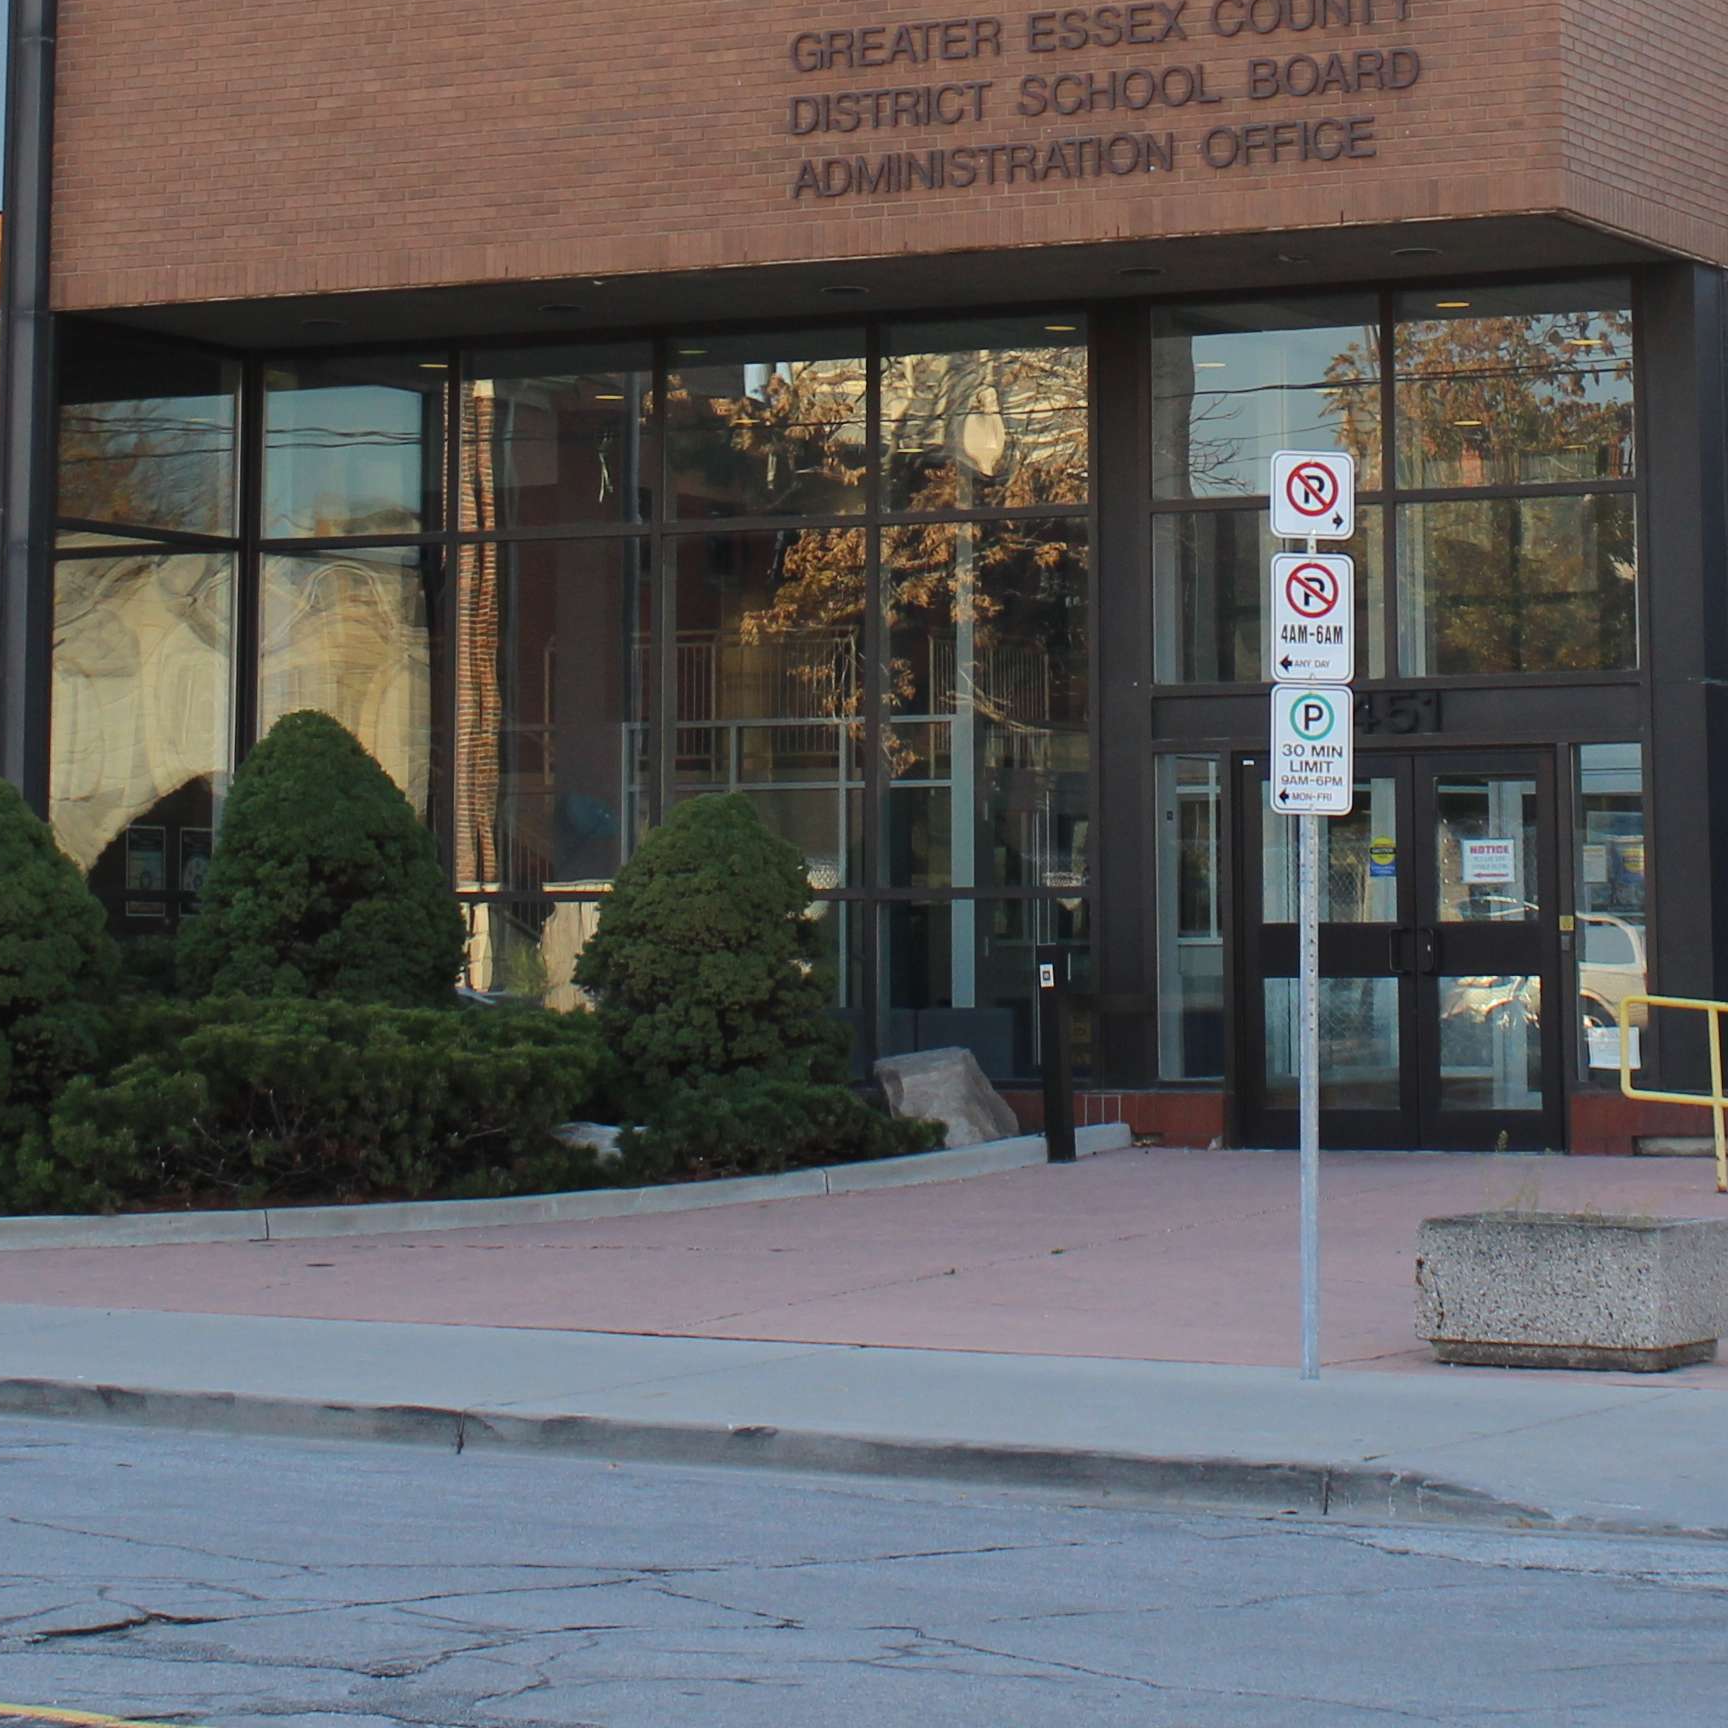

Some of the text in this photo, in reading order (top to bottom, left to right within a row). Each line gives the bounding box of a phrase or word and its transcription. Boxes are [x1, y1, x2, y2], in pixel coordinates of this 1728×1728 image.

[789, 16, 1002, 72] GREATER
[1027, 0, 1189, 53] ESSEX
[788, 47, 1421, 136] DISTRICT SCHOOL BOARD
[792, 116, 1377, 199] ADMINISTRATION OFFICE
[1280, 623, 1344, 645] 4AM-6AM
[1294, 659, 1330, 669] ANY DAY
[1304, 703, 1324, 731] P
[1281, 743, 1343, 758] 30 MIN
[1289, 759, 1334, 773] LIMIT
[1280, 774, 1343, 786] 9AM-6PM
[1292, 792, 1332, 802] MON-FRI
